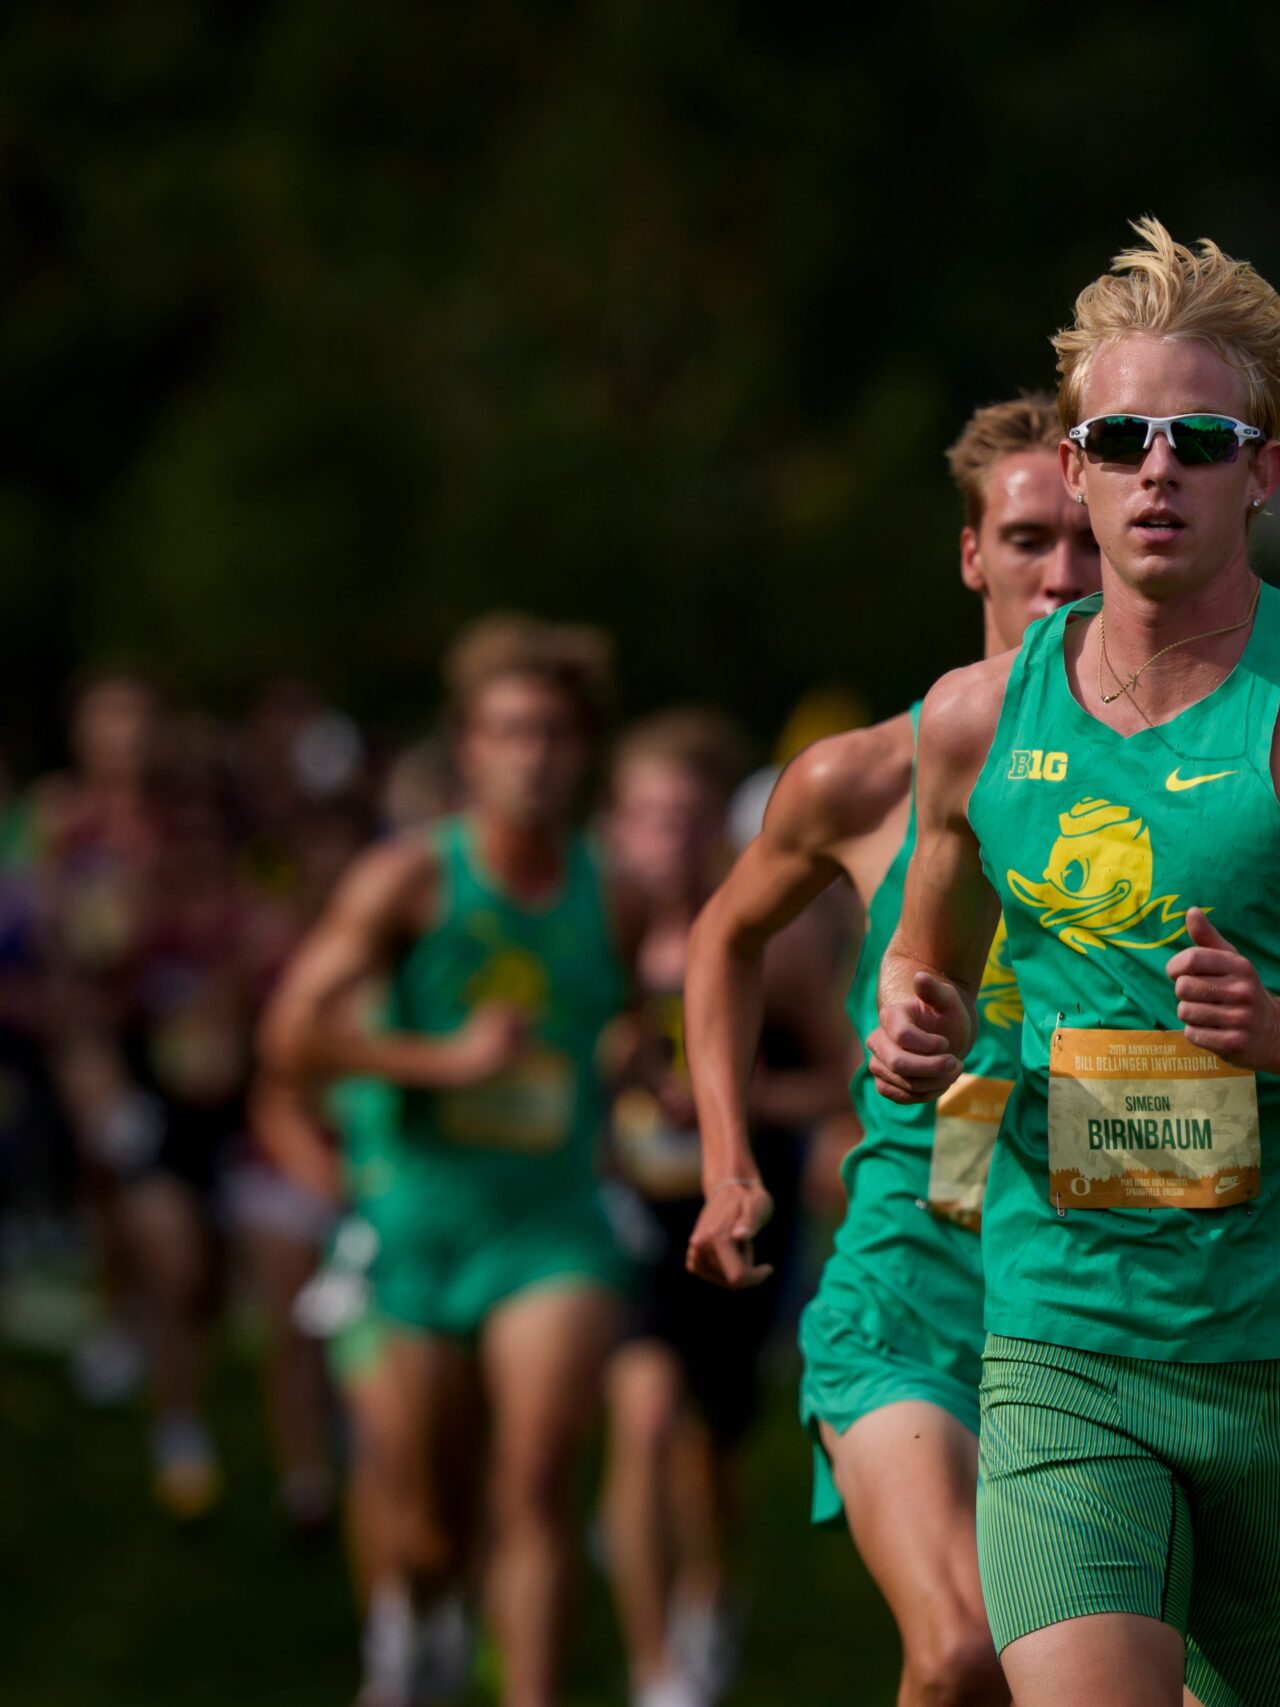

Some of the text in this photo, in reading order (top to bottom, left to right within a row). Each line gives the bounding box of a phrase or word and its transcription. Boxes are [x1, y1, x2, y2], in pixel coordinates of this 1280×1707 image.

[1128, 1044, 1176, 1055] ANNIVERSARY
[1075, 1056, 1219, 1072] BILL DELLINGER INVITATIONAL
[1125, 1095, 1171, 1112] SIMEON
[1088, 1119, 1213, 1150] BIRNBAUM
